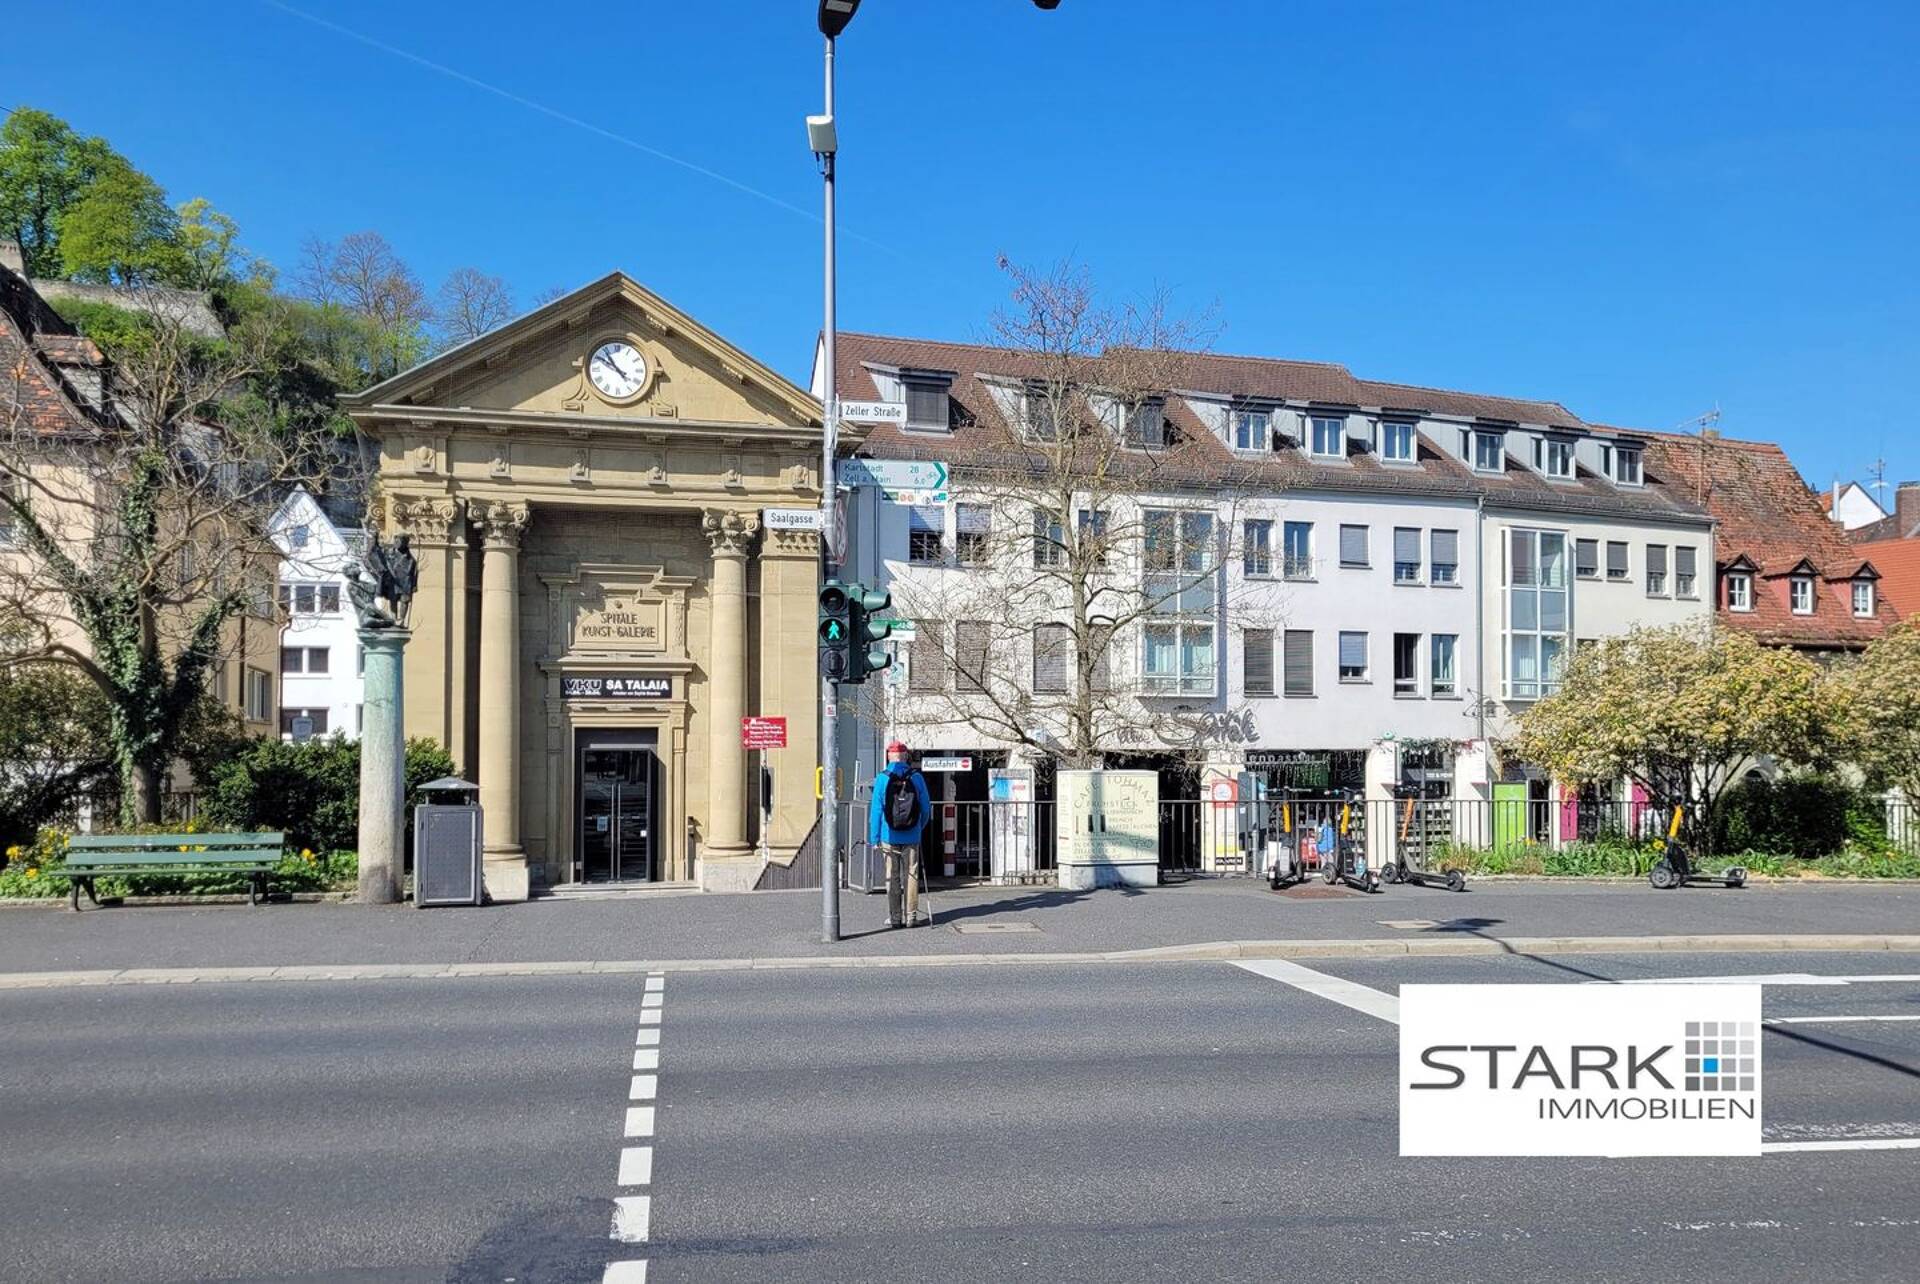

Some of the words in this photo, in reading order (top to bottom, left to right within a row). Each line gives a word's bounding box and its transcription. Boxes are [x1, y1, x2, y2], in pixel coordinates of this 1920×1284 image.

[845, 405, 869, 416] Zeller
[873, 406, 901, 418] Straße
[771, 512, 813, 526] Saalgasse
[605, 680, 623, 690] SA
[625, 680, 669, 690] TALAIA
[923, 759, 957, 769] Ausfahrt
